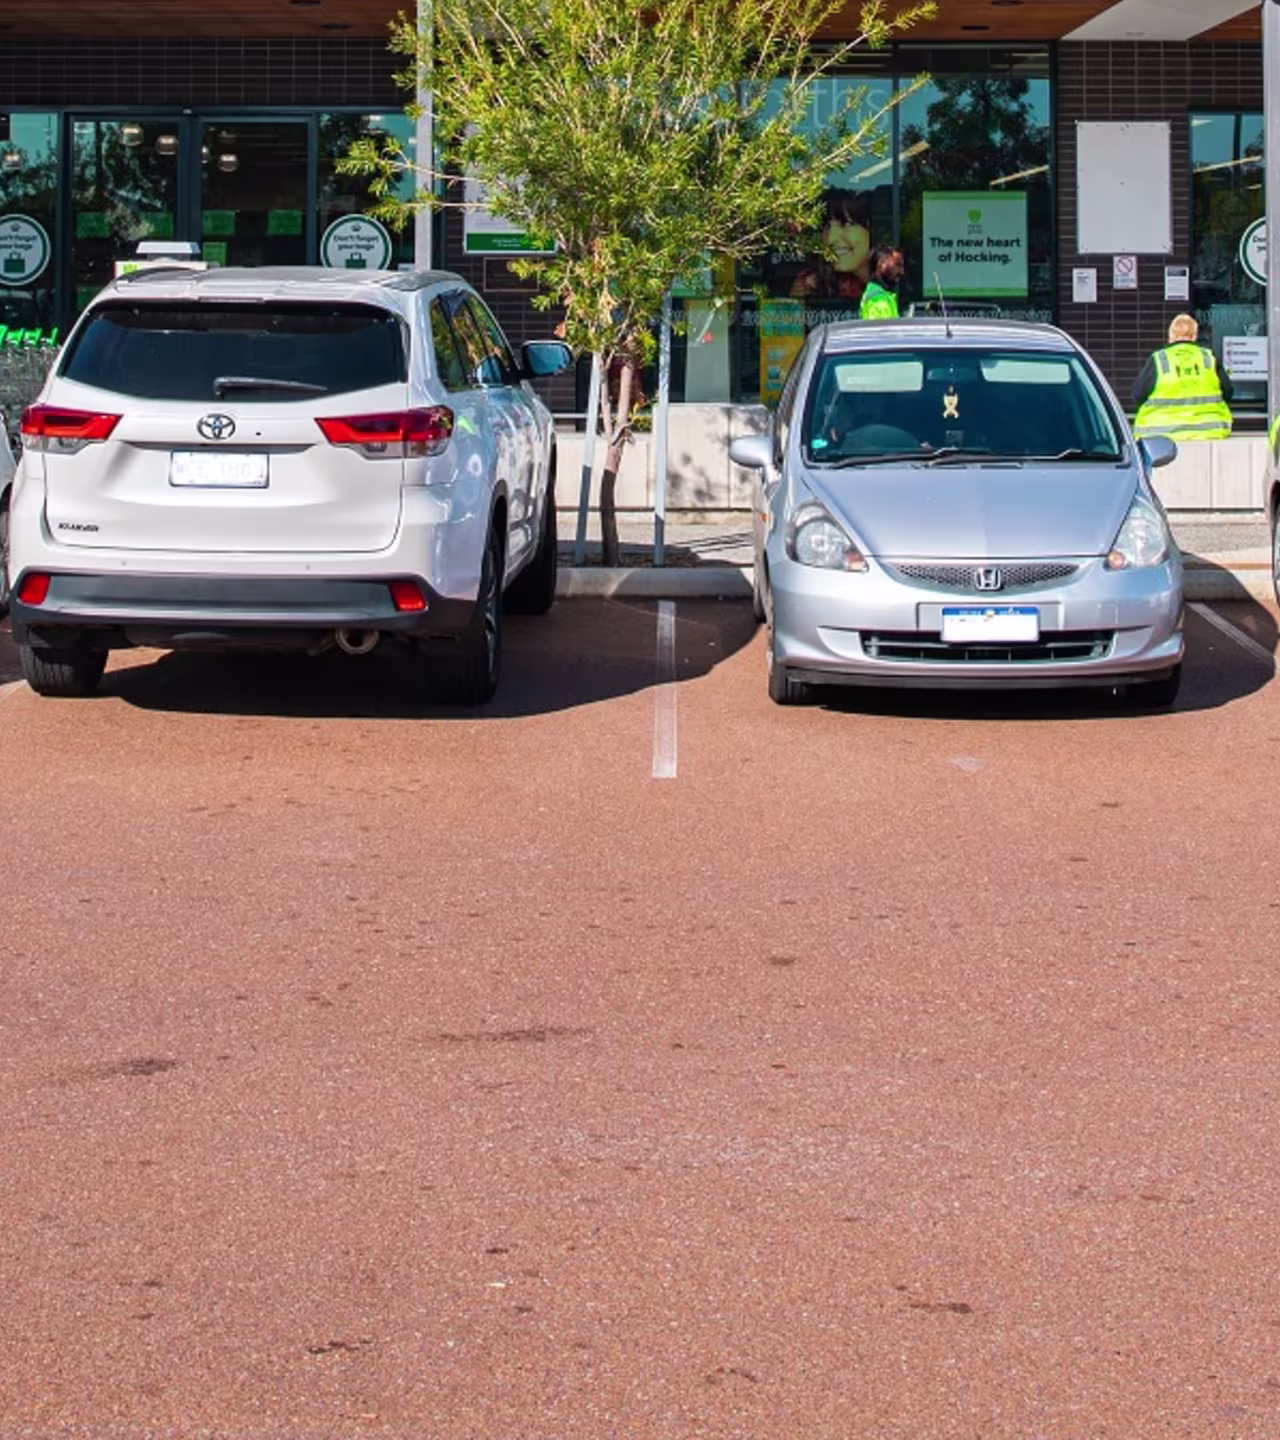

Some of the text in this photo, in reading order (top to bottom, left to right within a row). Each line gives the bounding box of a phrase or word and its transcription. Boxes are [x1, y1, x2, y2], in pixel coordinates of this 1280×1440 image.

[929, 237, 1021, 248] The new heart
[938, 251, 1013, 266] of Hocking.
